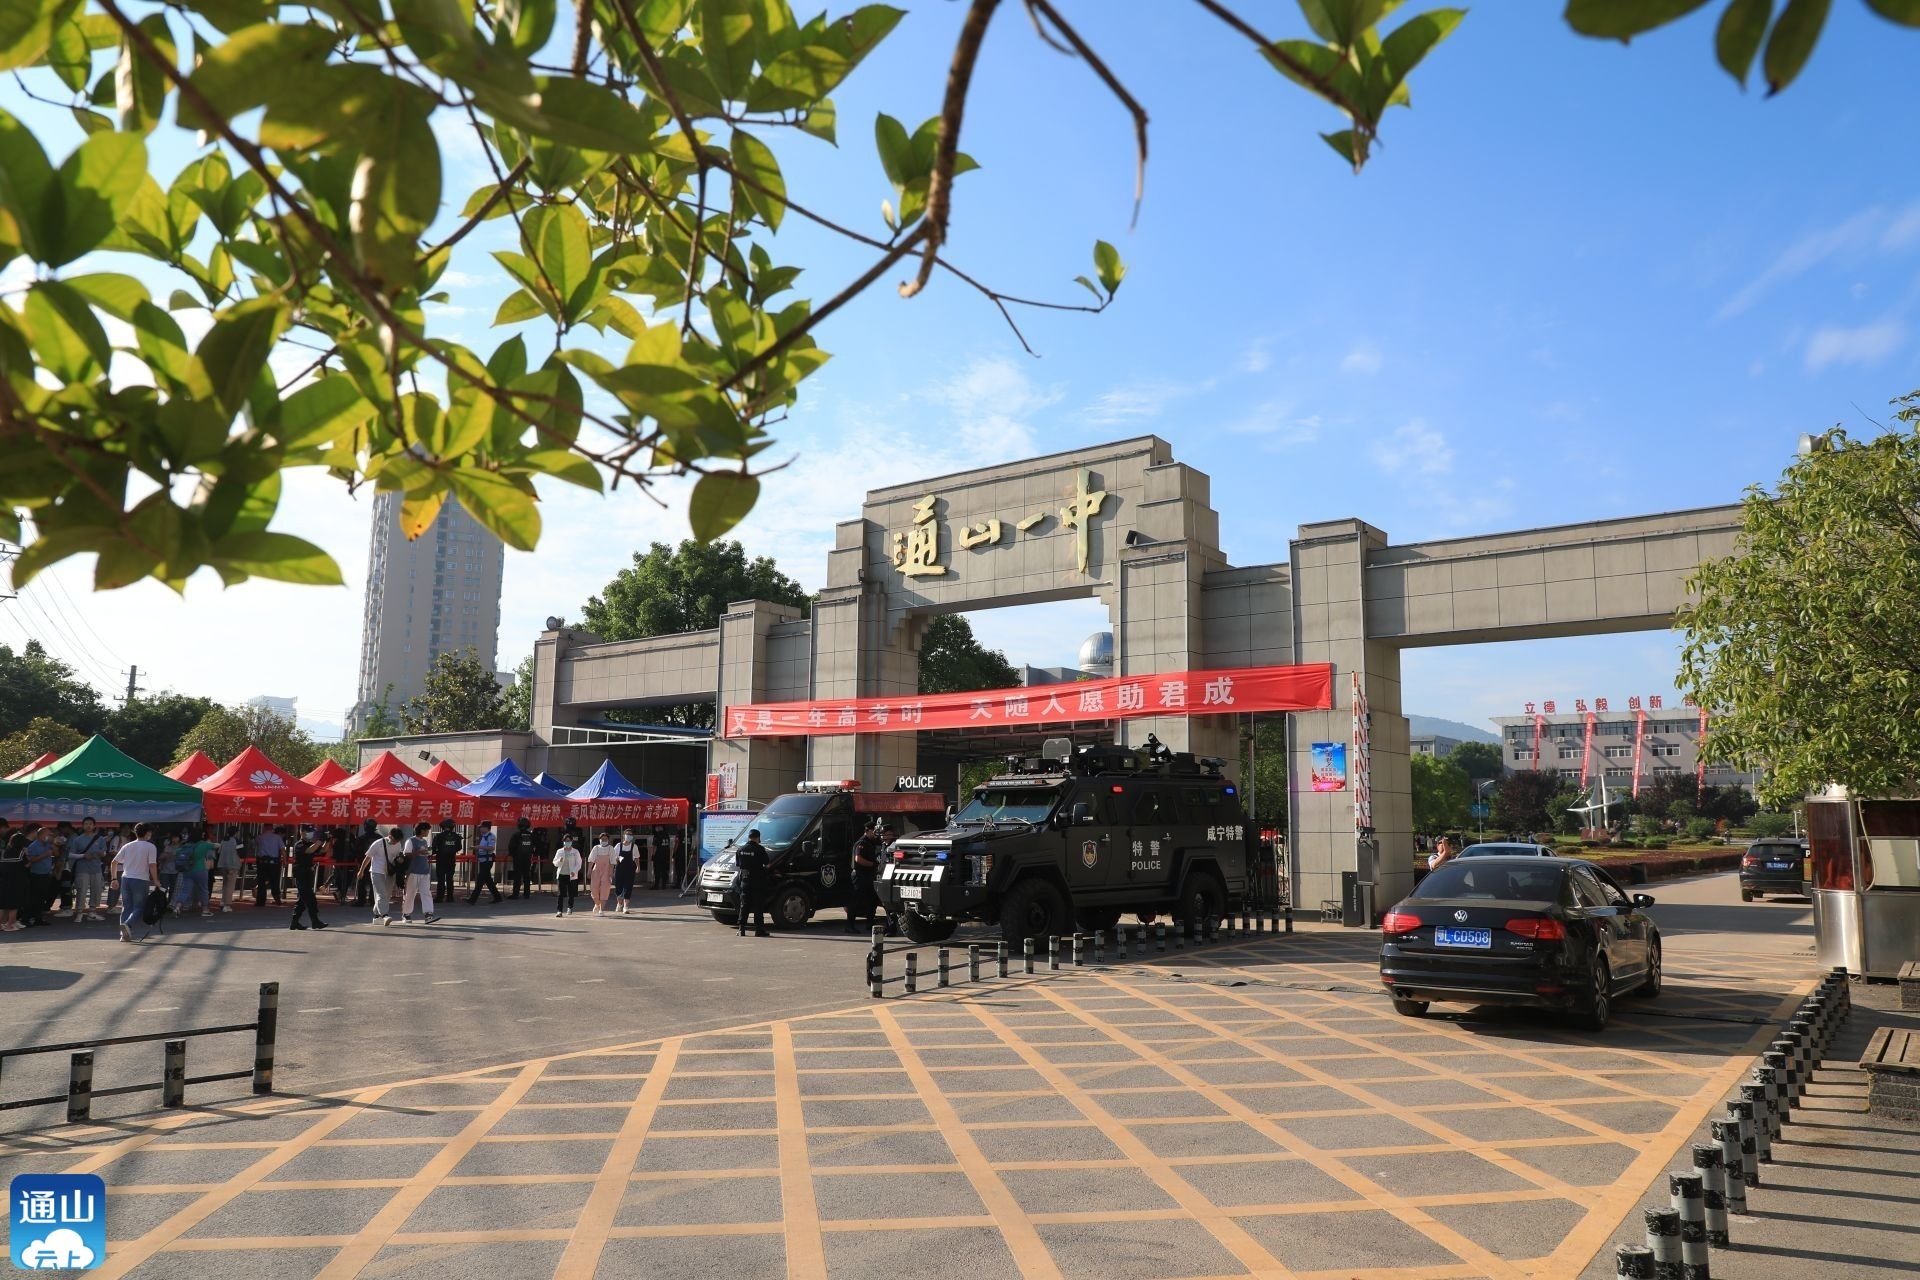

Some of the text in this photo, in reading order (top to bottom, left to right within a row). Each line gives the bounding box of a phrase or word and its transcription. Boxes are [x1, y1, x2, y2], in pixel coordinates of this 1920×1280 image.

[893, 468, 1108, 577] 通山一中
[731, 677, 1235, 732] 又是一年高考时 天随人愿助君成
[1524, 695, 1662, 714] 立德 弘毅 创新
[898, 775, 935, 789] POLICE
[259, 797, 475, 819] 上大学就带天翼云电脑
[1207, 825, 1244, 841] 咸宁特警
[1132, 840, 1161, 857] 特警
[1131, 860, 1161, 871] POLICE
